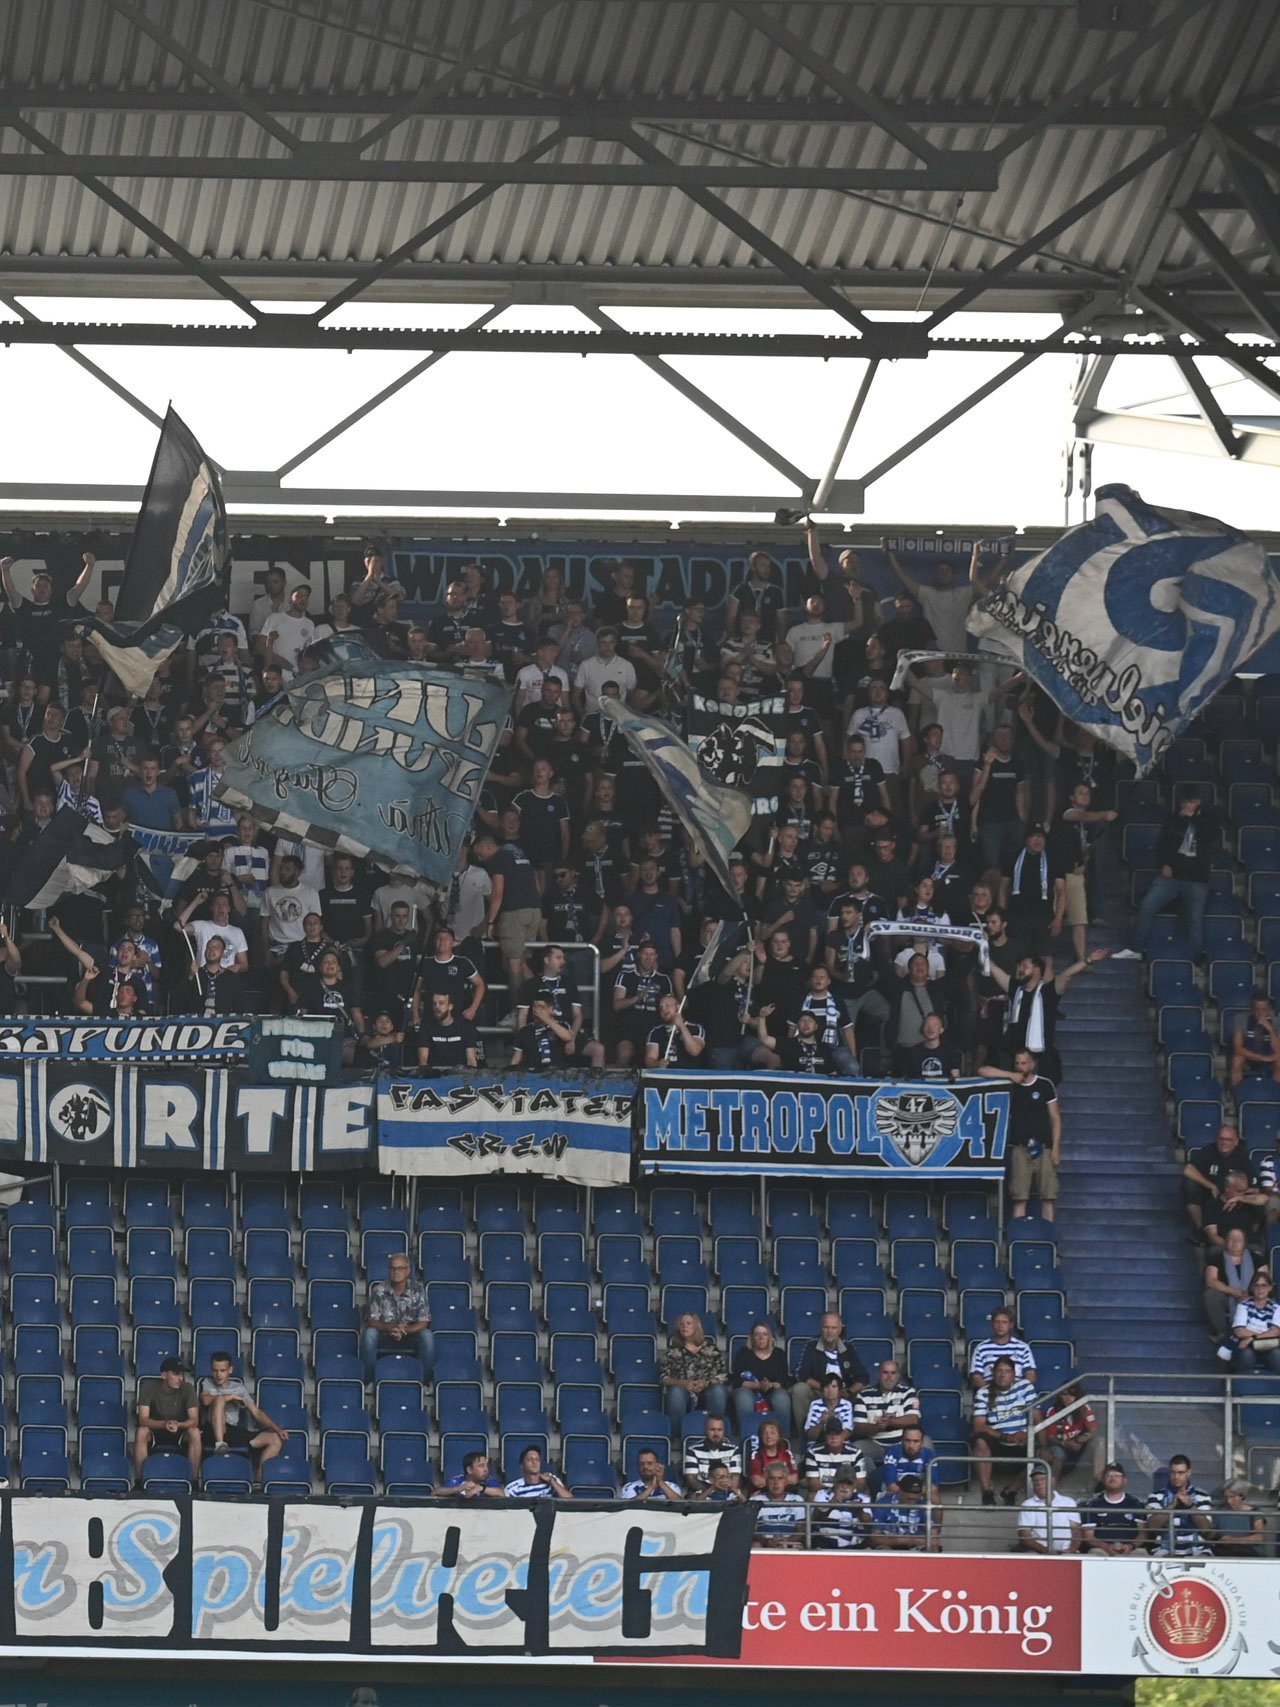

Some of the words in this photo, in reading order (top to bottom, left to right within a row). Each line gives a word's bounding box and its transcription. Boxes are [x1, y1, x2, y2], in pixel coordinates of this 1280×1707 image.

[693, 694, 786, 718] KOHORTE
[644, 1087, 884, 1156] METROPOL
[904, 1096, 927, 1112] 47
[957, 1089, 1011, 1159] 47
[447, 1132, 569, 1161] CREW
[799, 1588, 879, 1632] ein
[894, 1588, 1053, 1656] König
[1129, 1581, 1148, 1632] PURUM
[1210, 1567, 1248, 1629] LAUDATUR
